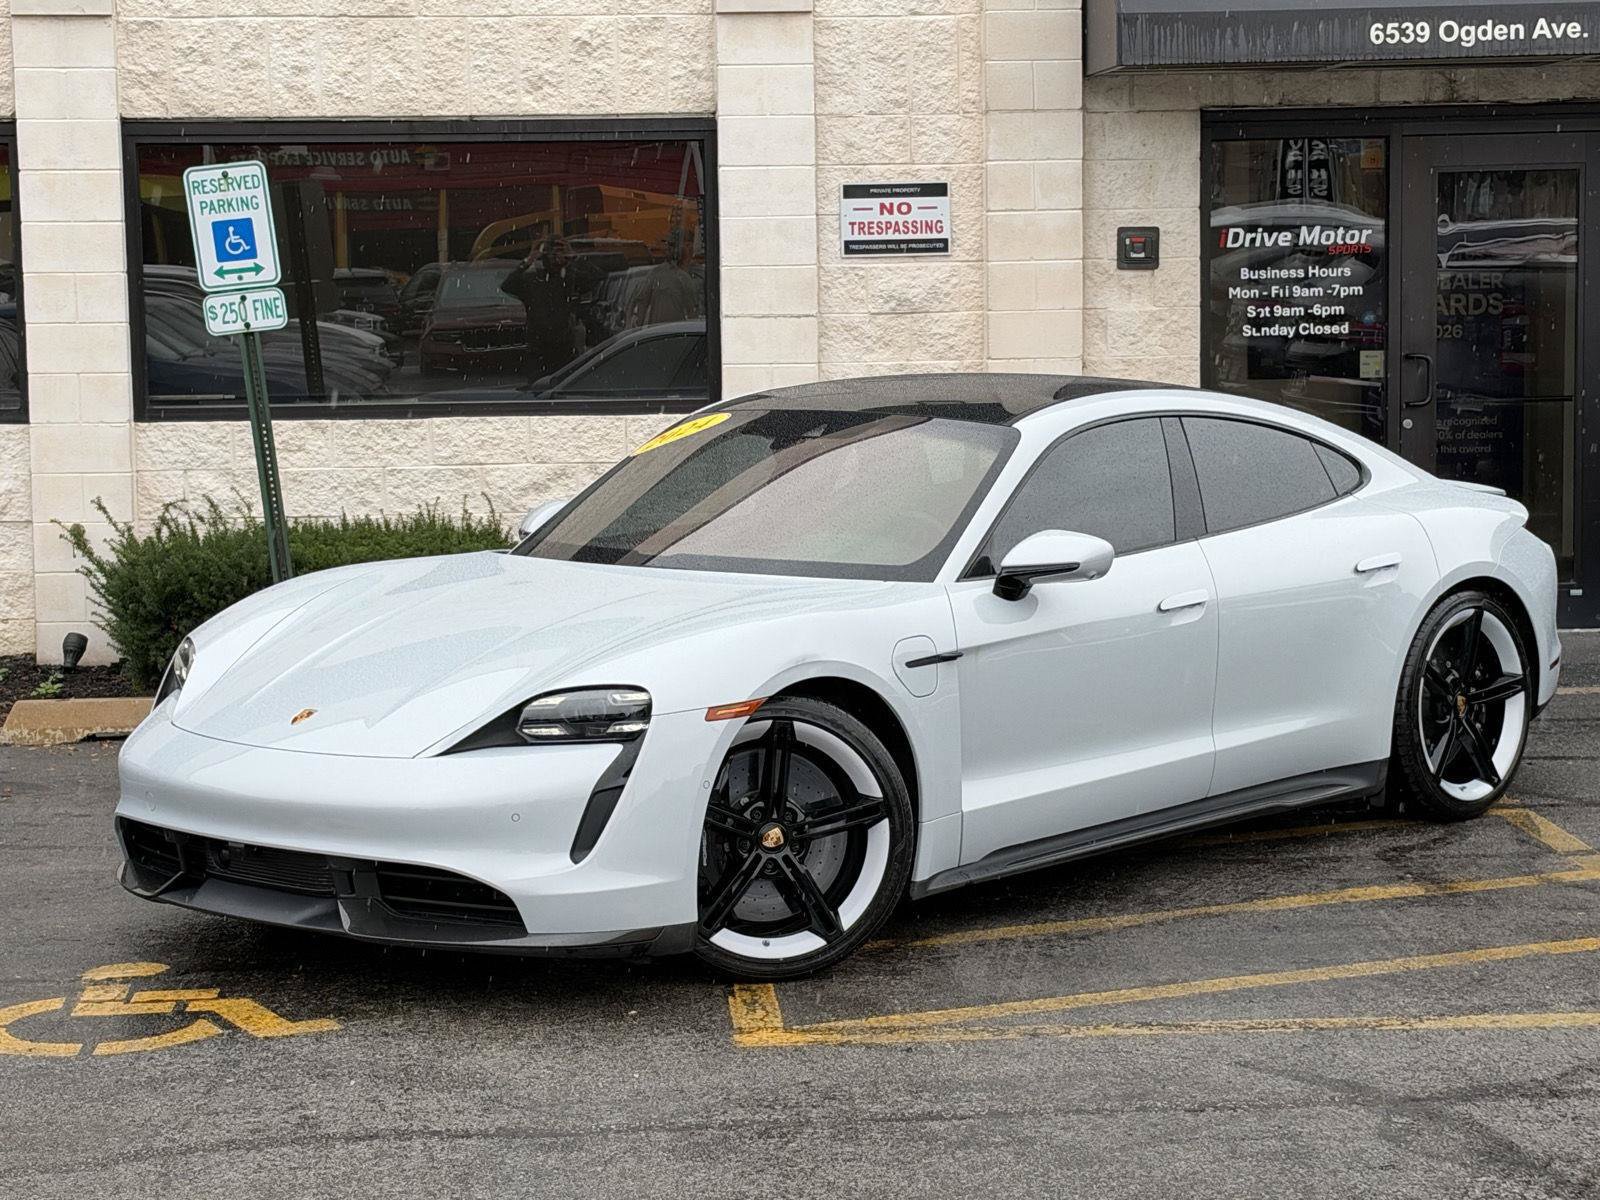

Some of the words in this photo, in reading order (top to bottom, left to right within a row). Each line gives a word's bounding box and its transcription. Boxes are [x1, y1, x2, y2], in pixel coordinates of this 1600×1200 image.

[1369, 22, 1430, 45] 6539
[1439, 19, 1525, 47] Ogden
[1531, 17, 1589, 39] Ave.
[191, 174, 261, 196] RESERVED
[200, 195, 260, 216] PARKING
[879, 202, 912, 216] NO
[848, 219, 944, 236] TRESPASSING
[1218, 226, 1292, 248] iDrive
[1298, 225, 1373, 245] Motor
[1327, 243, 1373, 255] SPORTS
[1240, 266, 1305, 280] Business
[1308, 265, 1351, 278] Hours
[1437, 272, 1503, 289] EALER
[1228, 286, 1259, 299] Mon
[1271, 285, 1289, 298] Fri
[1292, 285, 1323, 298] 9am
[252, 296, 283, 321] FINE
[1273, 304, 1304, 317] 9am
[1299, 321, 1349, 336] Closed
